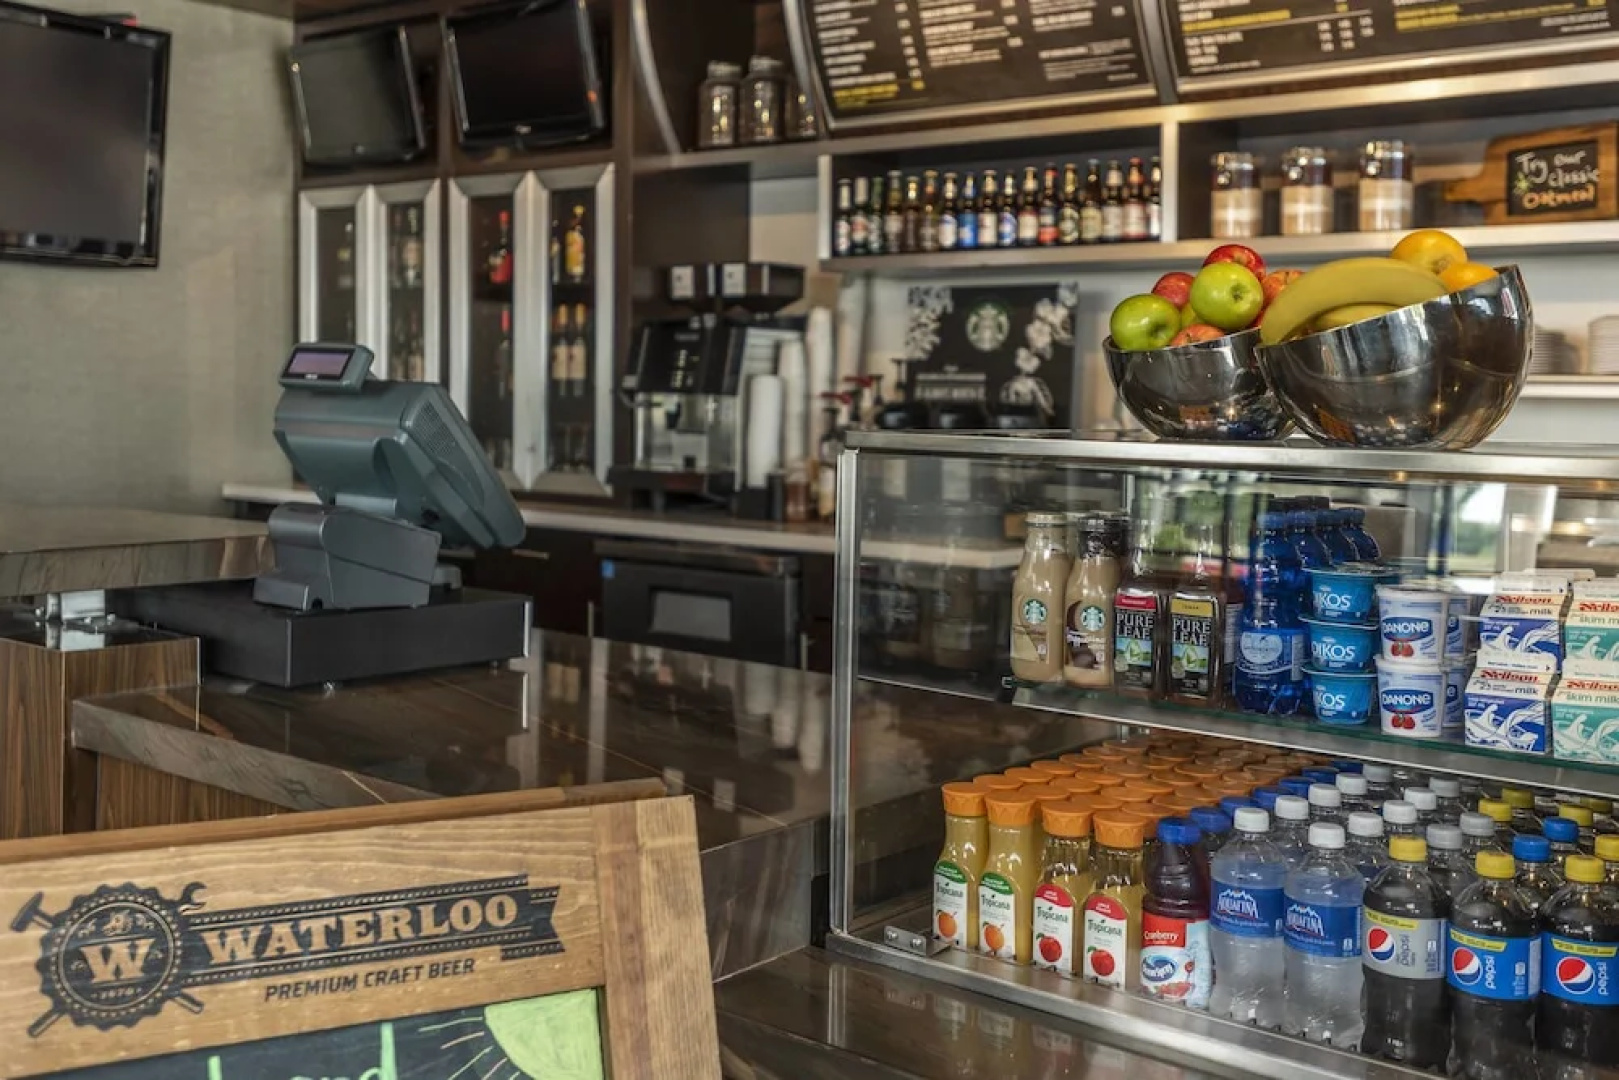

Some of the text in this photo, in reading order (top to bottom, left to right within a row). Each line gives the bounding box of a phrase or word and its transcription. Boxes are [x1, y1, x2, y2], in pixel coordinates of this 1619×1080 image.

[1515, 150, 1586, 184] Try our
[1116, 613, 1154, 628] PURE
[1172, 617, 1212, 634] PURE
[1116, 624, 1151, 641] LEAF
[1172, 630, 1208, 647] LEAF
[981, 893, 1011, 911] Tropicana
[1036, 905, 1069, 923] Tropicana
[201, 894, 518, 965] WATERLOO
[1087, 919, 1123, 937] Tropicana
[1144, 929, 1179, 943] Cranberry
[79, 938, 156, 984] W
[264, 957, 477, 1002] PREMIUM CRAFT BEER
[1483, 954, 1497, 990] pepsi
[1595, 961, 1610, 996] pepsi
